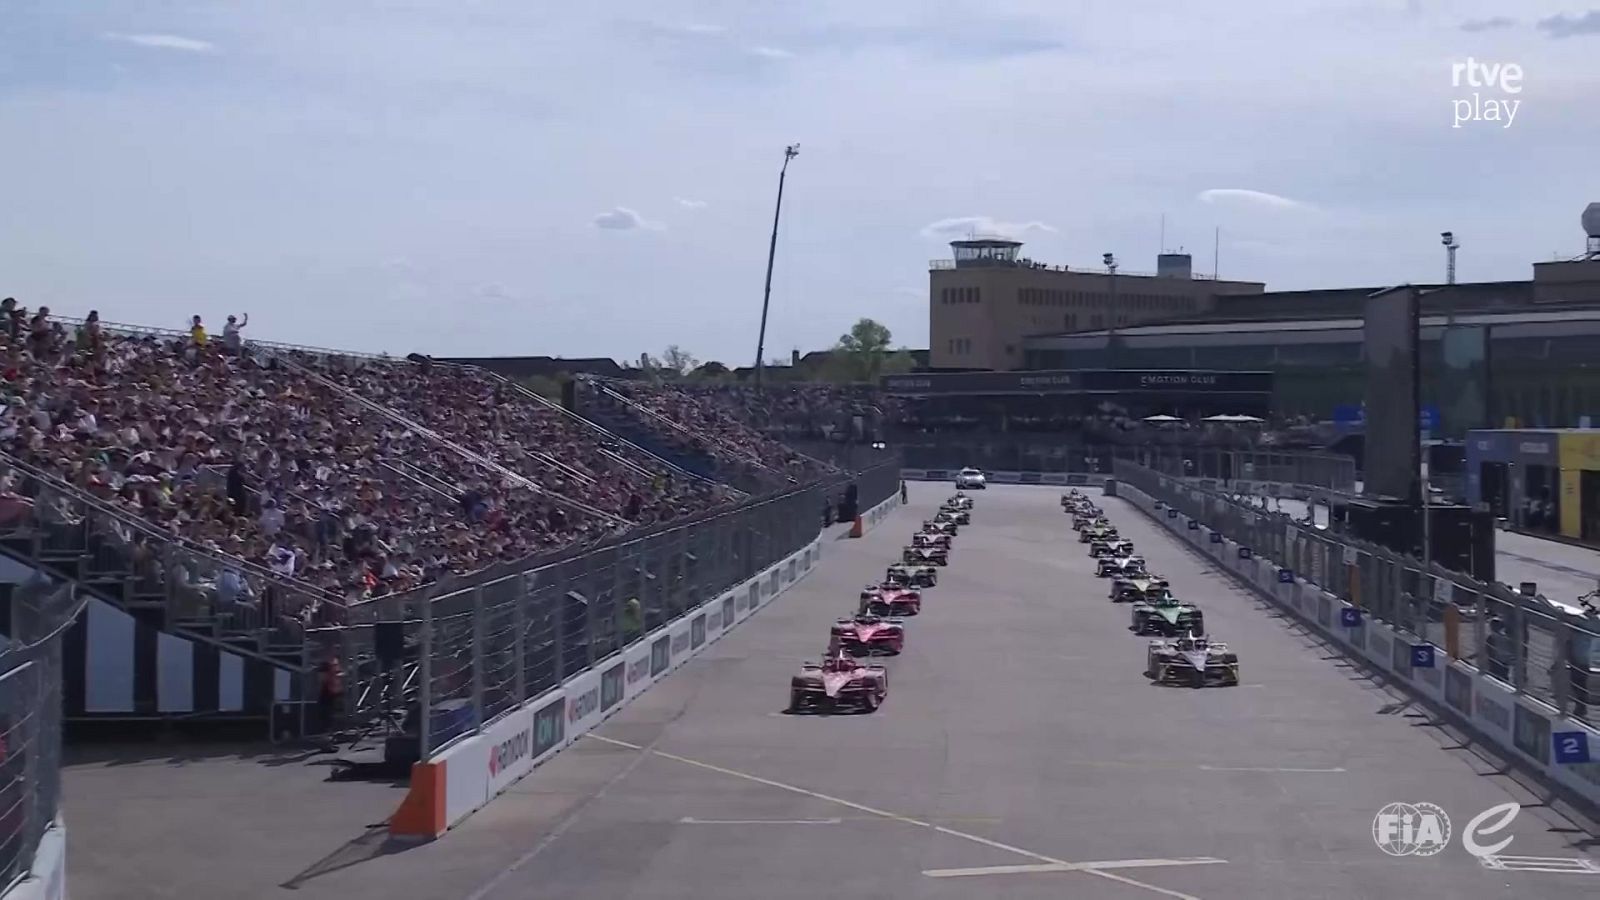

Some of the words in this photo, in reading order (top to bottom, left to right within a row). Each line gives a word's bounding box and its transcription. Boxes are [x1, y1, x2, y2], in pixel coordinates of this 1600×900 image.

[1140, 375, 1187, 384] EMOTION
[1190, 375, 1216, 384] CLUB
[1418, 650, 1429, 662] 3
[1563, 738, 1579, 753] 2
